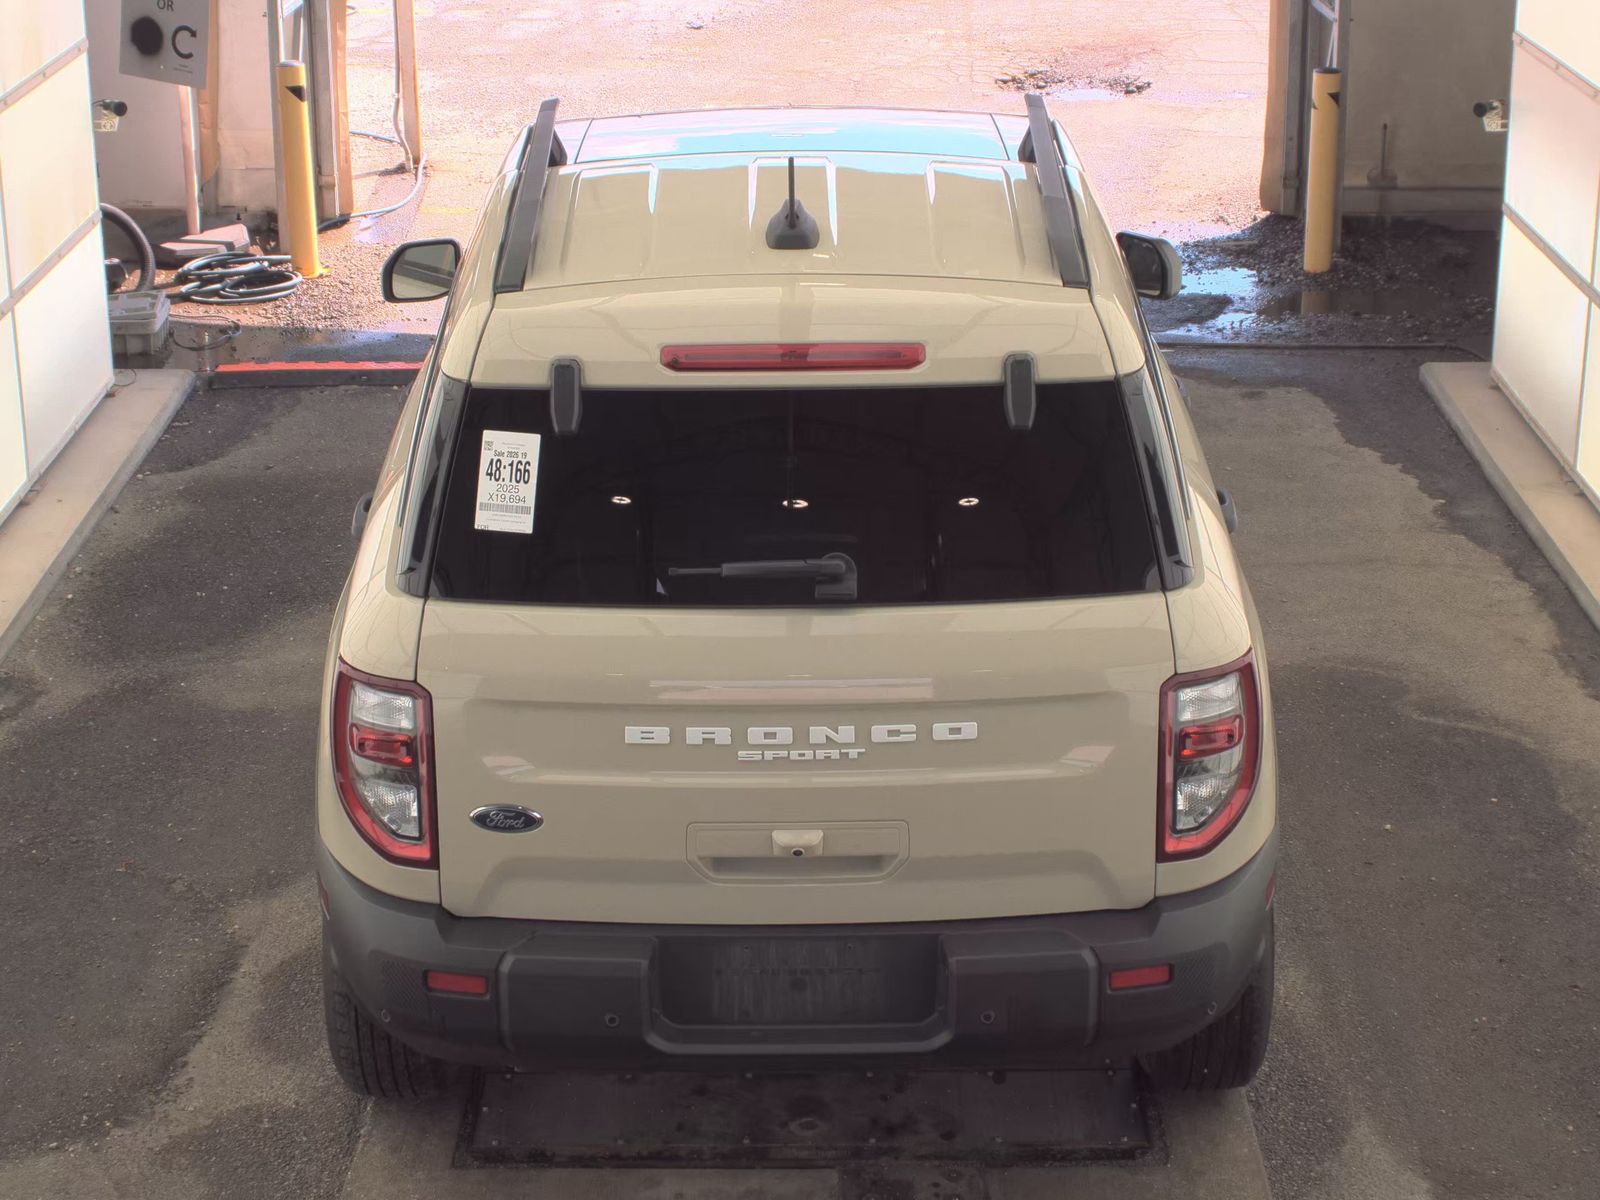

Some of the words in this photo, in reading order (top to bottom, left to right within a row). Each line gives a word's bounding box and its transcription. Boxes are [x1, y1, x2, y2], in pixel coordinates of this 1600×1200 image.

[157, 0, 174, 11] OR
[494, 449, 505, 457] Sale
[486, 458, 531, 485] 48:166
[496, 484, 519, 494] 2025
[624, 722, 978, 745] BRONCO
[737, 748, 866, 761] SPORT
[486, 810, 526, 828] Ford
